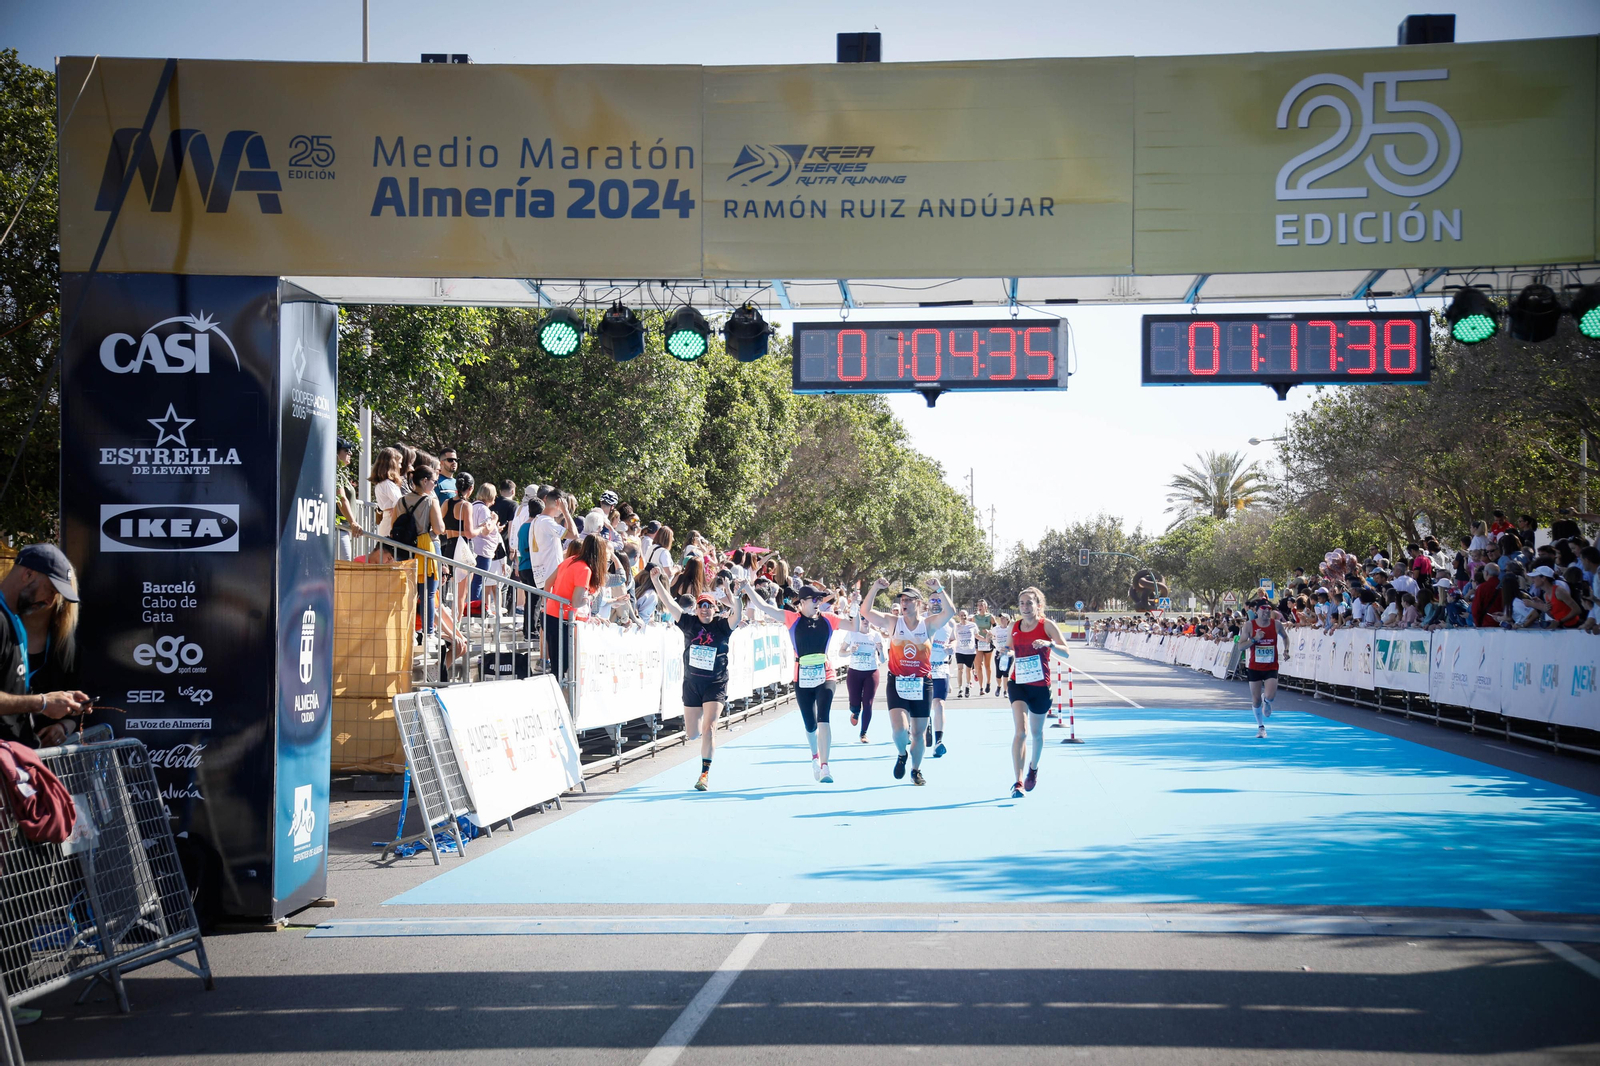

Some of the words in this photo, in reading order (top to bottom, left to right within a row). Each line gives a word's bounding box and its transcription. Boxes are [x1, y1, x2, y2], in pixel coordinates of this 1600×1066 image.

[1275, 68, 1462, 200] 25
[289, 135, 335, 168] 25
[373, 136, 498, 168] Medio
[520, 137, 694, 170] Maratón
[808, 145, 876, 161] RFEA
[288, 169, 336, 180] EDICIÓN
[801, 163, 868, 175] SERIES
[796, 175, 838, 186] RUTA
[842, 175, 907, 186] RUNNING
[370, 176, 555, 219] Almería
[566, 178, 696, 219] 2024
[724, 194, 827, 219] RAMÓN
[841, 198, 906, 219] RUIZ
[918, 192, 1055, 218] ANDÚJAR
[1275, 202, 1462, 246] EDICIÓN
[99, 332, 211, 374] CASI
[99, 447, 242, 465] ESTRELLA
[132, 466, 150, 475] DE
[152, 466, 210, 475] LEVANTE
[120, 518, 224, 538] IKEA
[142, 581, 196, 594] Barceló
[142, 596, 177, 608] Cabo
[180, 596, 197, 608] de
[142, 610, 174, 623] Gata
[133, 635, 204, 674] ego
[178, 667, 191, 675] sport
[802, 668, 823, 676] 5697
[126, 690, 165, 702] SER
[190, 689, 213, 706] 40
[294, 690, 320, 711] ALMERÍA
[126, 721, 139, 729] La
[140, 721, 158, 729] Voz
[159, 721, 171, 729] de
[172, 719, 211, 729] Almería
[129, 783, 205, 800] Analucía
